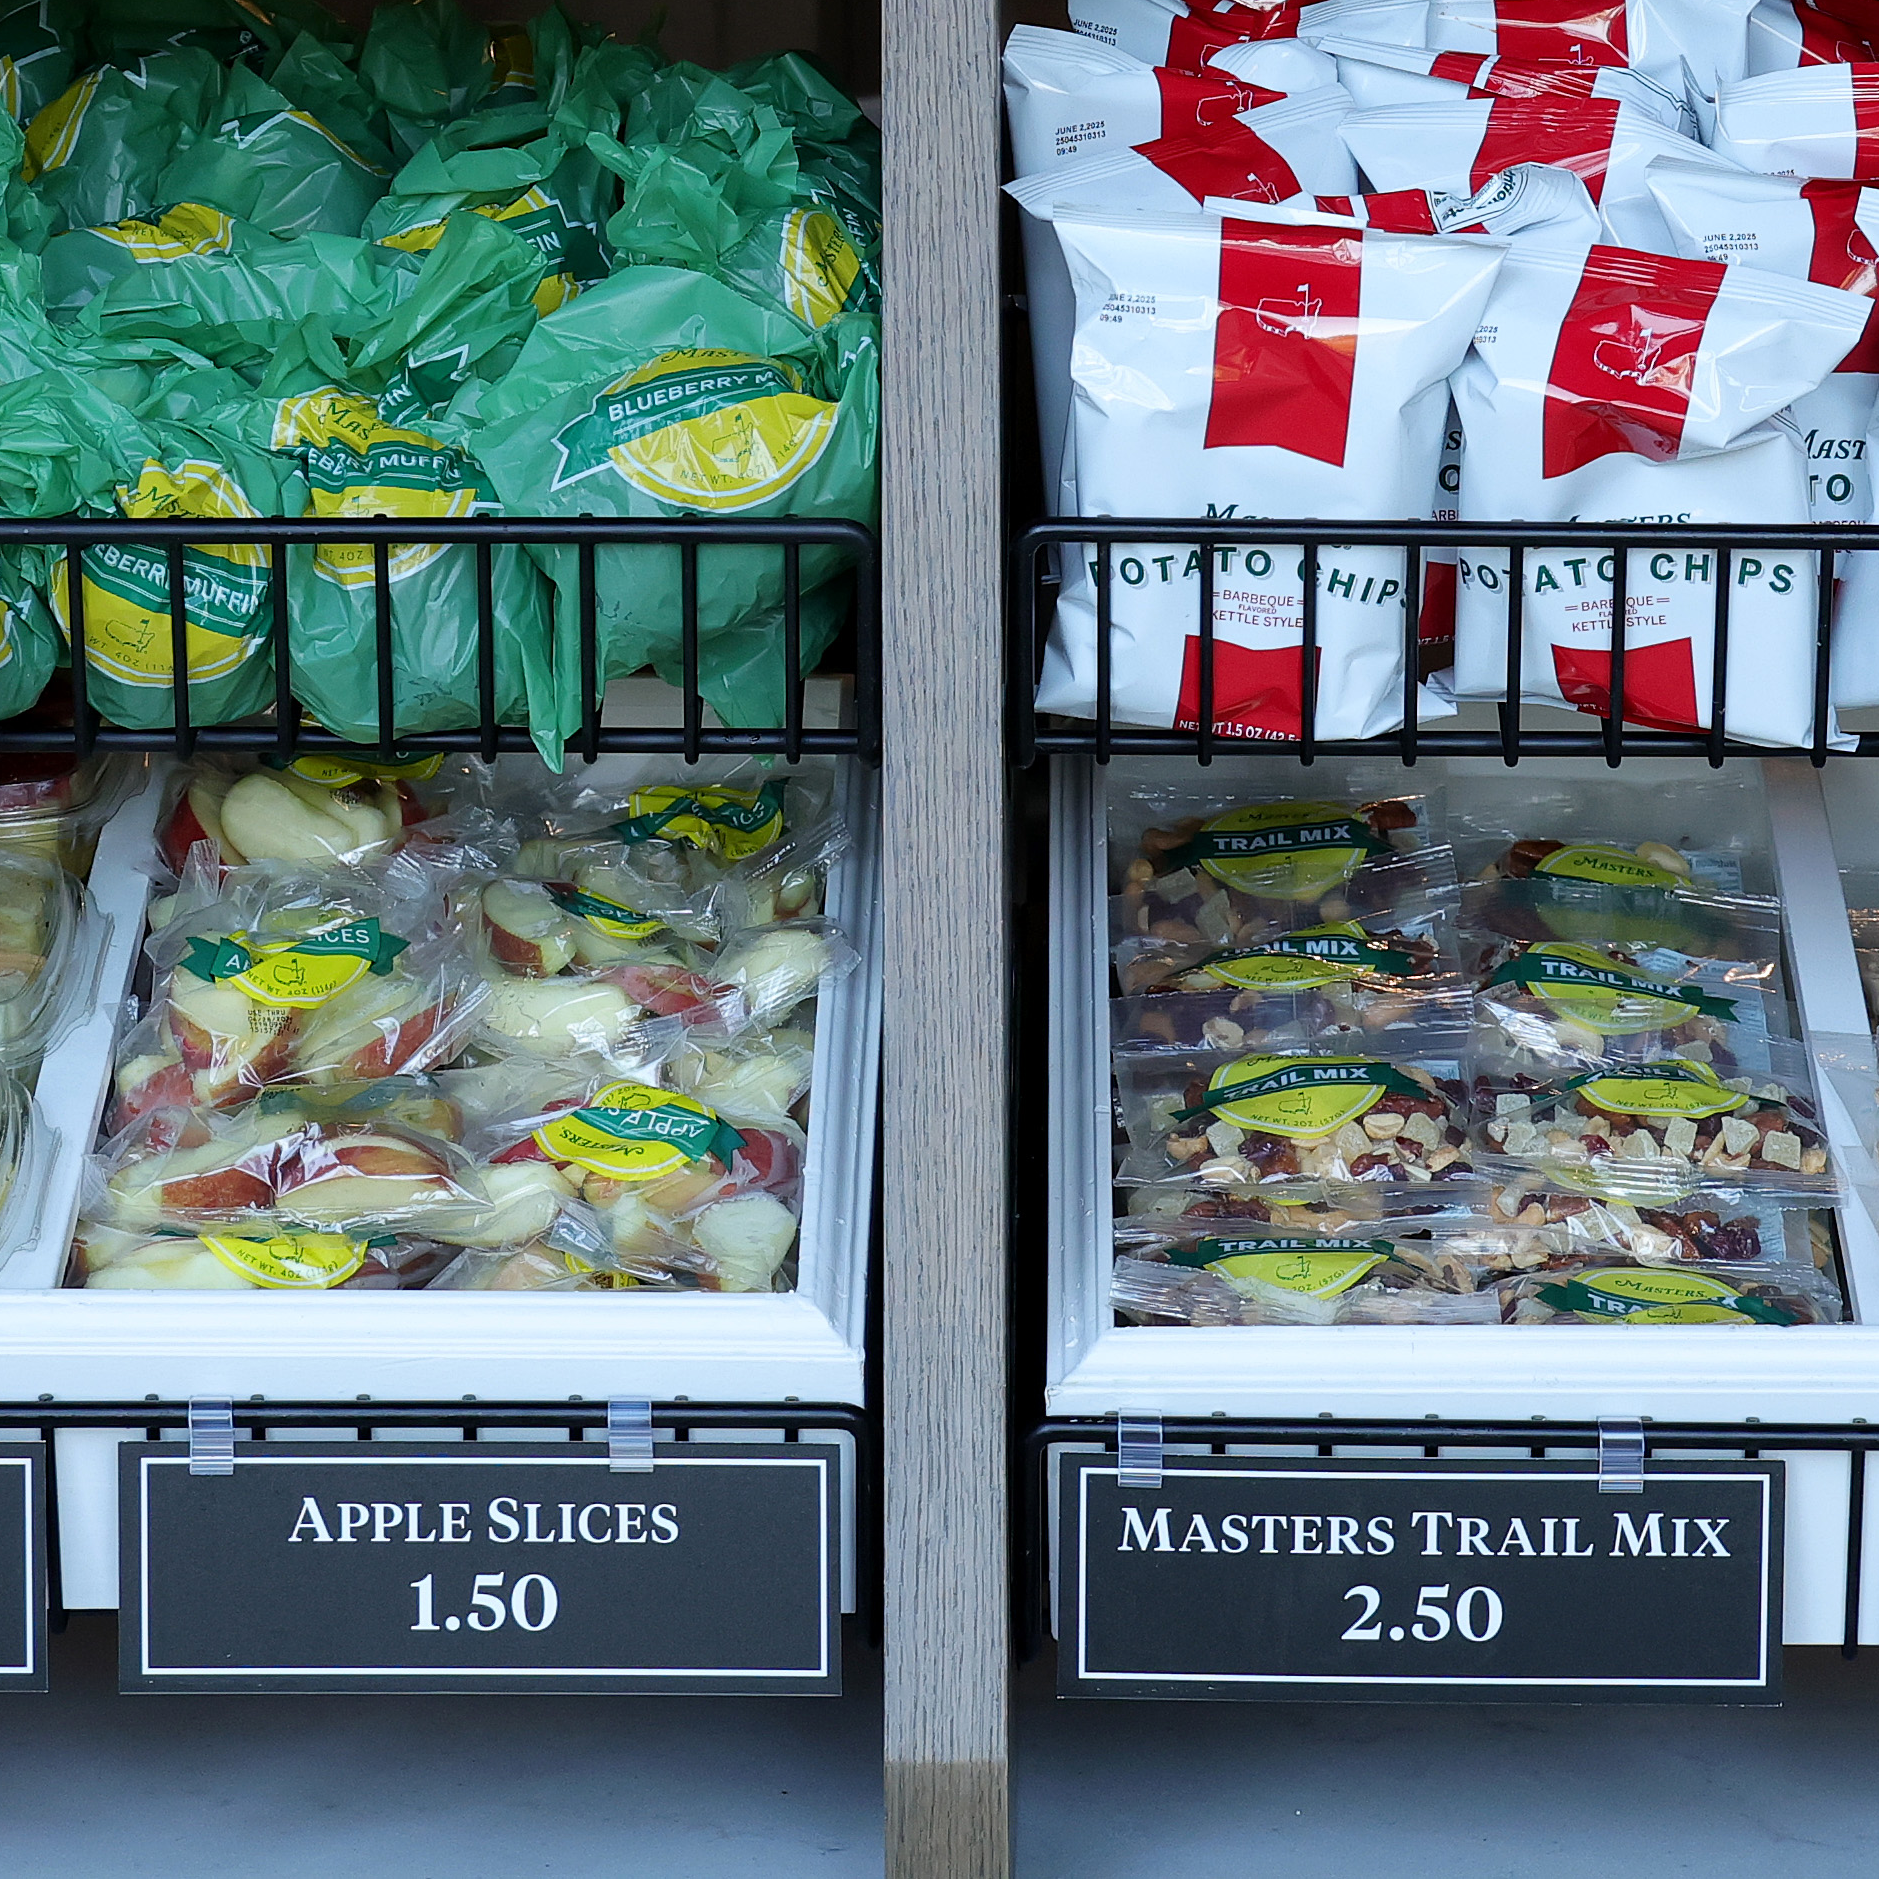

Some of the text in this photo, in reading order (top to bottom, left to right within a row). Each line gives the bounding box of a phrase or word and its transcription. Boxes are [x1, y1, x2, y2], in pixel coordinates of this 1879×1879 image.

[608, 372, 748, 422] BLUEBERRY
[1460, 552, 1796, 595] POATO CHPS
[1223, 589, 1295, 607] BARBEQUE
[1213, 825, 1351, 851] TRAIL MIX
[1574, 855, 1655, 878] MASTERS
[1306, 940, 1360, 956] MIX
[1541, 962, 1623, 985] TRAIL
[1314, 1068, 1369, 1079] MIX
[1219, 1239, 1372, 1251] TRAIL MIX
[288, 1498, 678, 1543] APPLE SLICES
[1118, 1508, 1730, 1556] MASTERS TRAIL MIX
[411, 1572, 557, 1631] 1.50
[1342, 1584, 1502, 1641] 2.50
